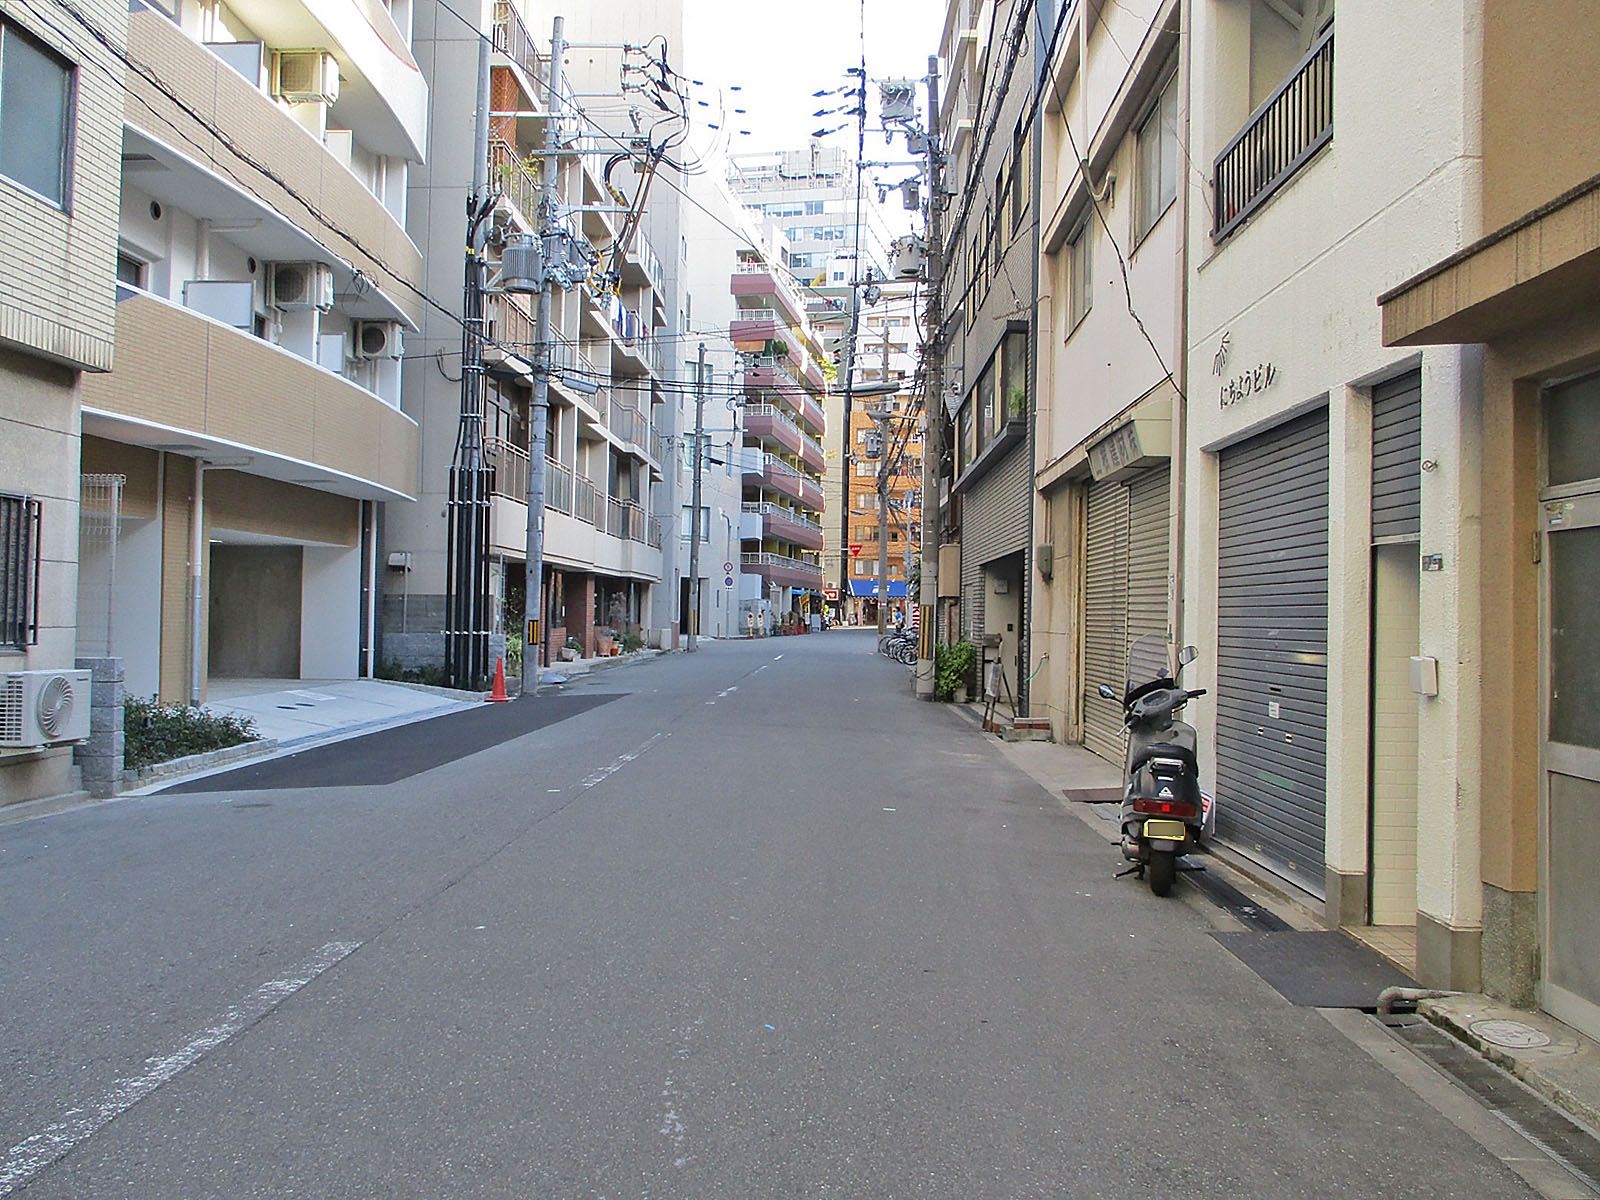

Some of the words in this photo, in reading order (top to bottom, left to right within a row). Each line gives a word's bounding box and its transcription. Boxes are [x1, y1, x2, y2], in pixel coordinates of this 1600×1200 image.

[1219, 362, 1276, 410] にちょうビル
